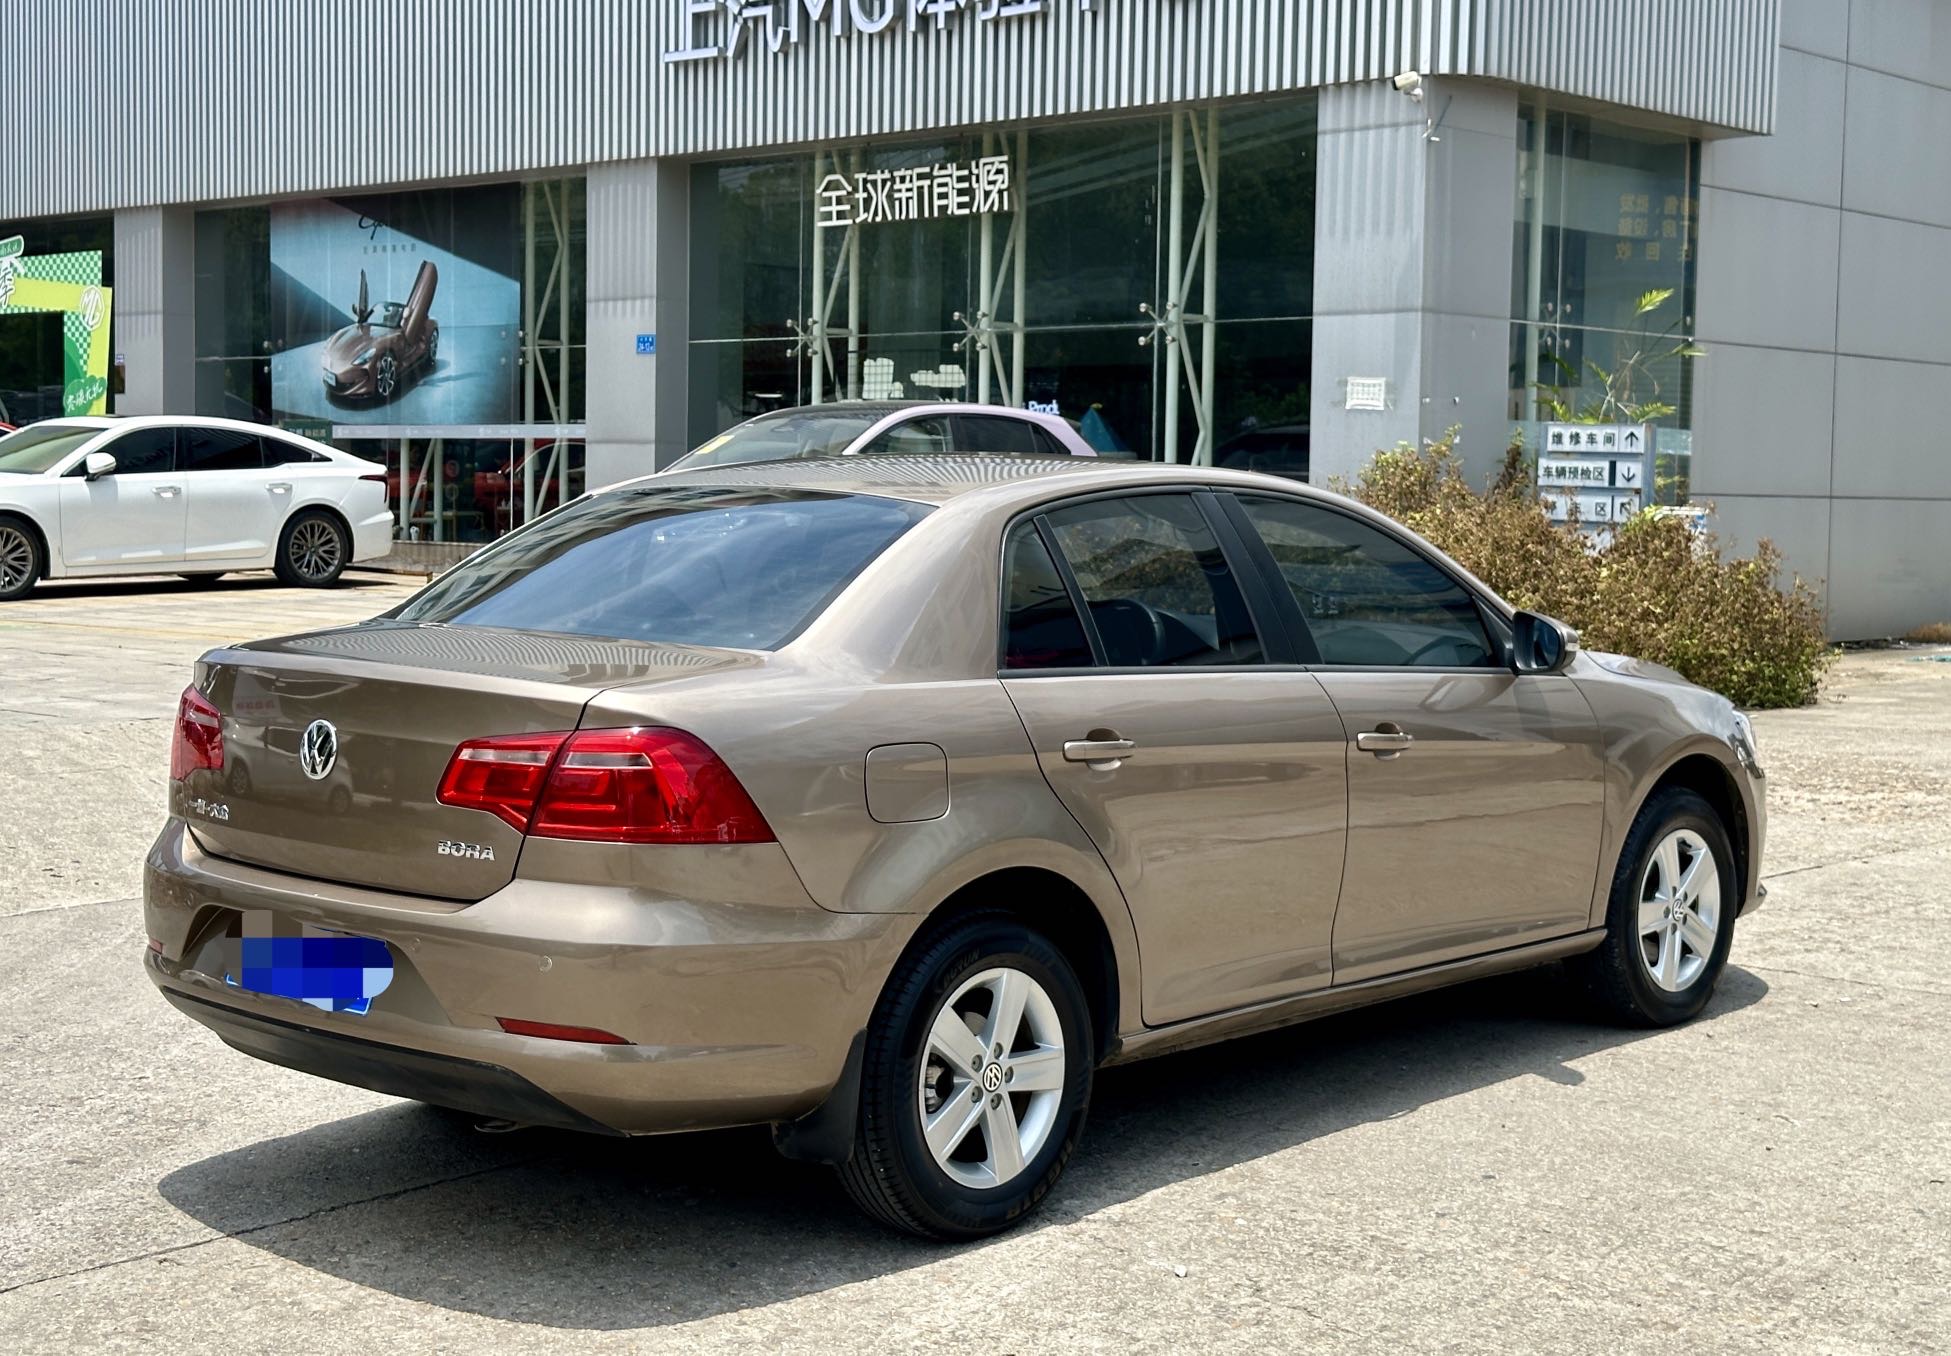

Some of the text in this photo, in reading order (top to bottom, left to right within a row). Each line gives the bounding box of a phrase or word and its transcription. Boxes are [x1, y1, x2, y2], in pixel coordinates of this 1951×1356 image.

[816, 155, 1010, 227] 全球新能源
[1551, 432, 1616, 446] 维修车间
[1542, 466, 1606, 481] 车辆预检区
[437, 840, 496, 861] BORA
